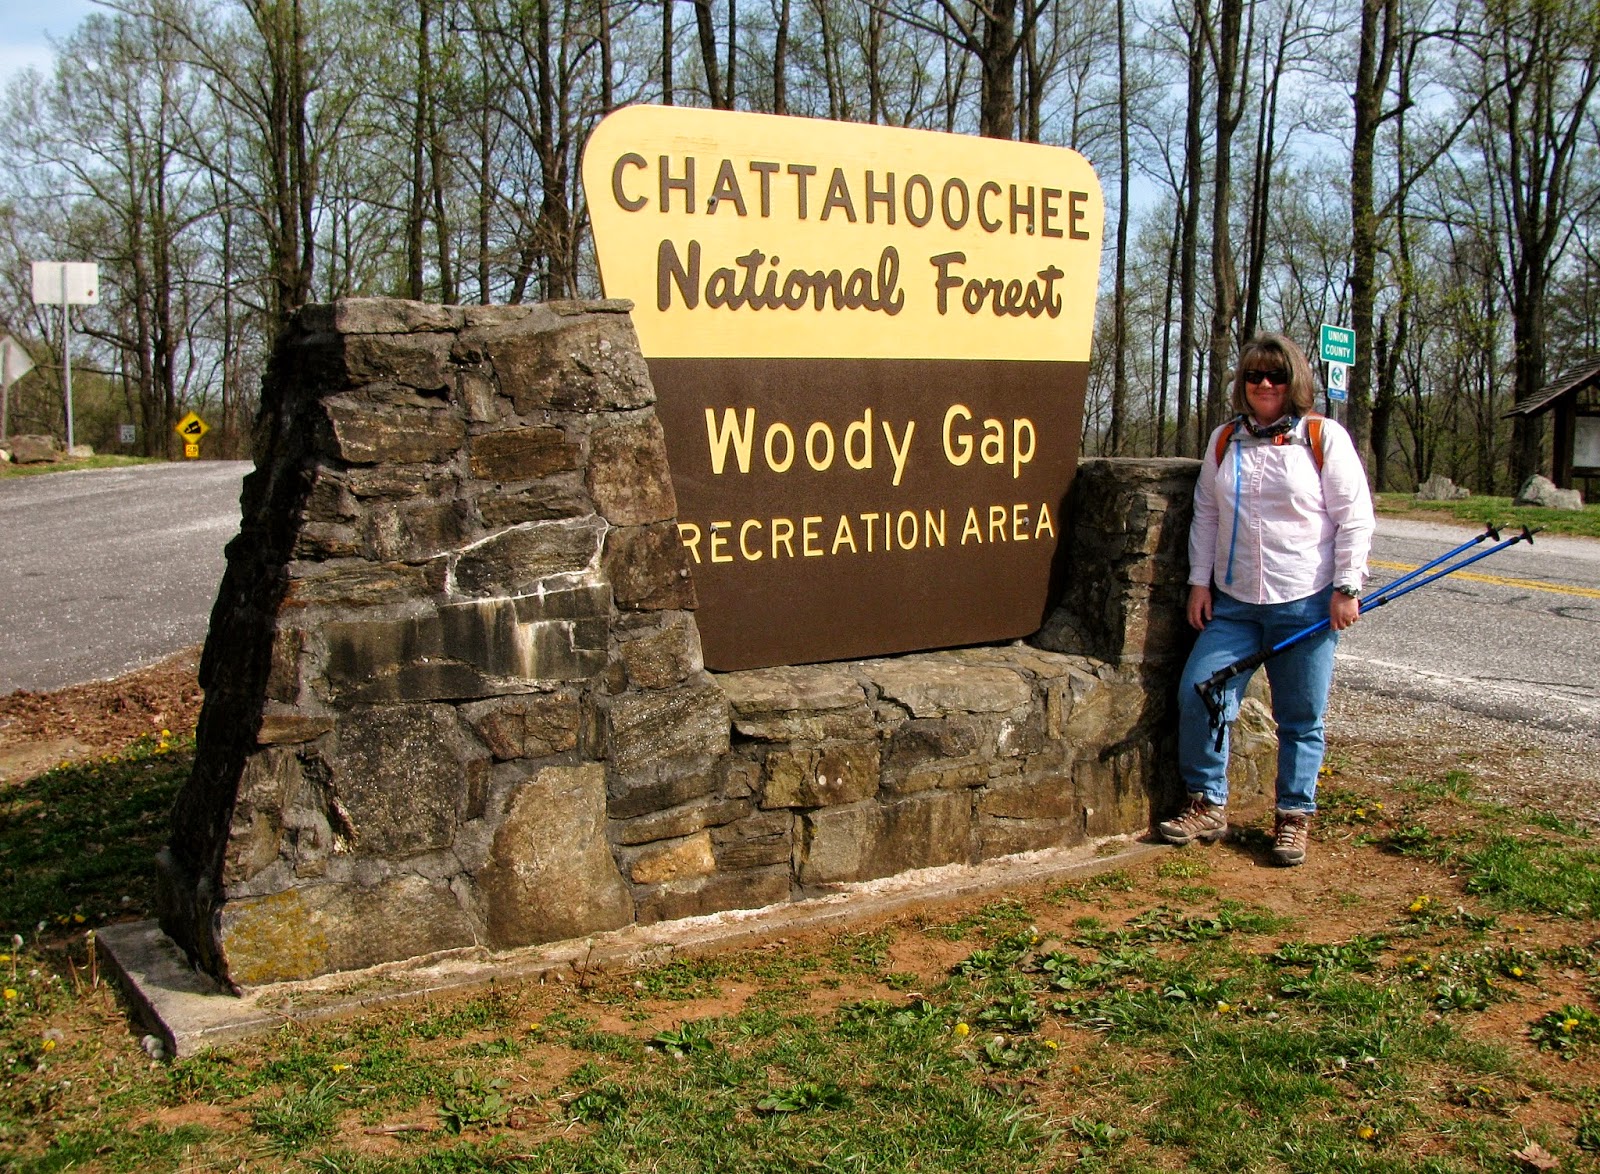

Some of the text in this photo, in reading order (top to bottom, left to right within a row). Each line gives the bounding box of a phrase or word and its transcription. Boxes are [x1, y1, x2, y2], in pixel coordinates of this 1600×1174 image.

[612, 152, 1090, 240] CHATTAHOOCHEE
[656, 238, 1065, 319] National Forest
[1325, 344, 1351, 358] COUNTY
[1328, 330, 1349, 343] UNION
[704, 403, 1037, 487] Woody Gap
[678, 502, 1056, 563] RECREATION AREA
